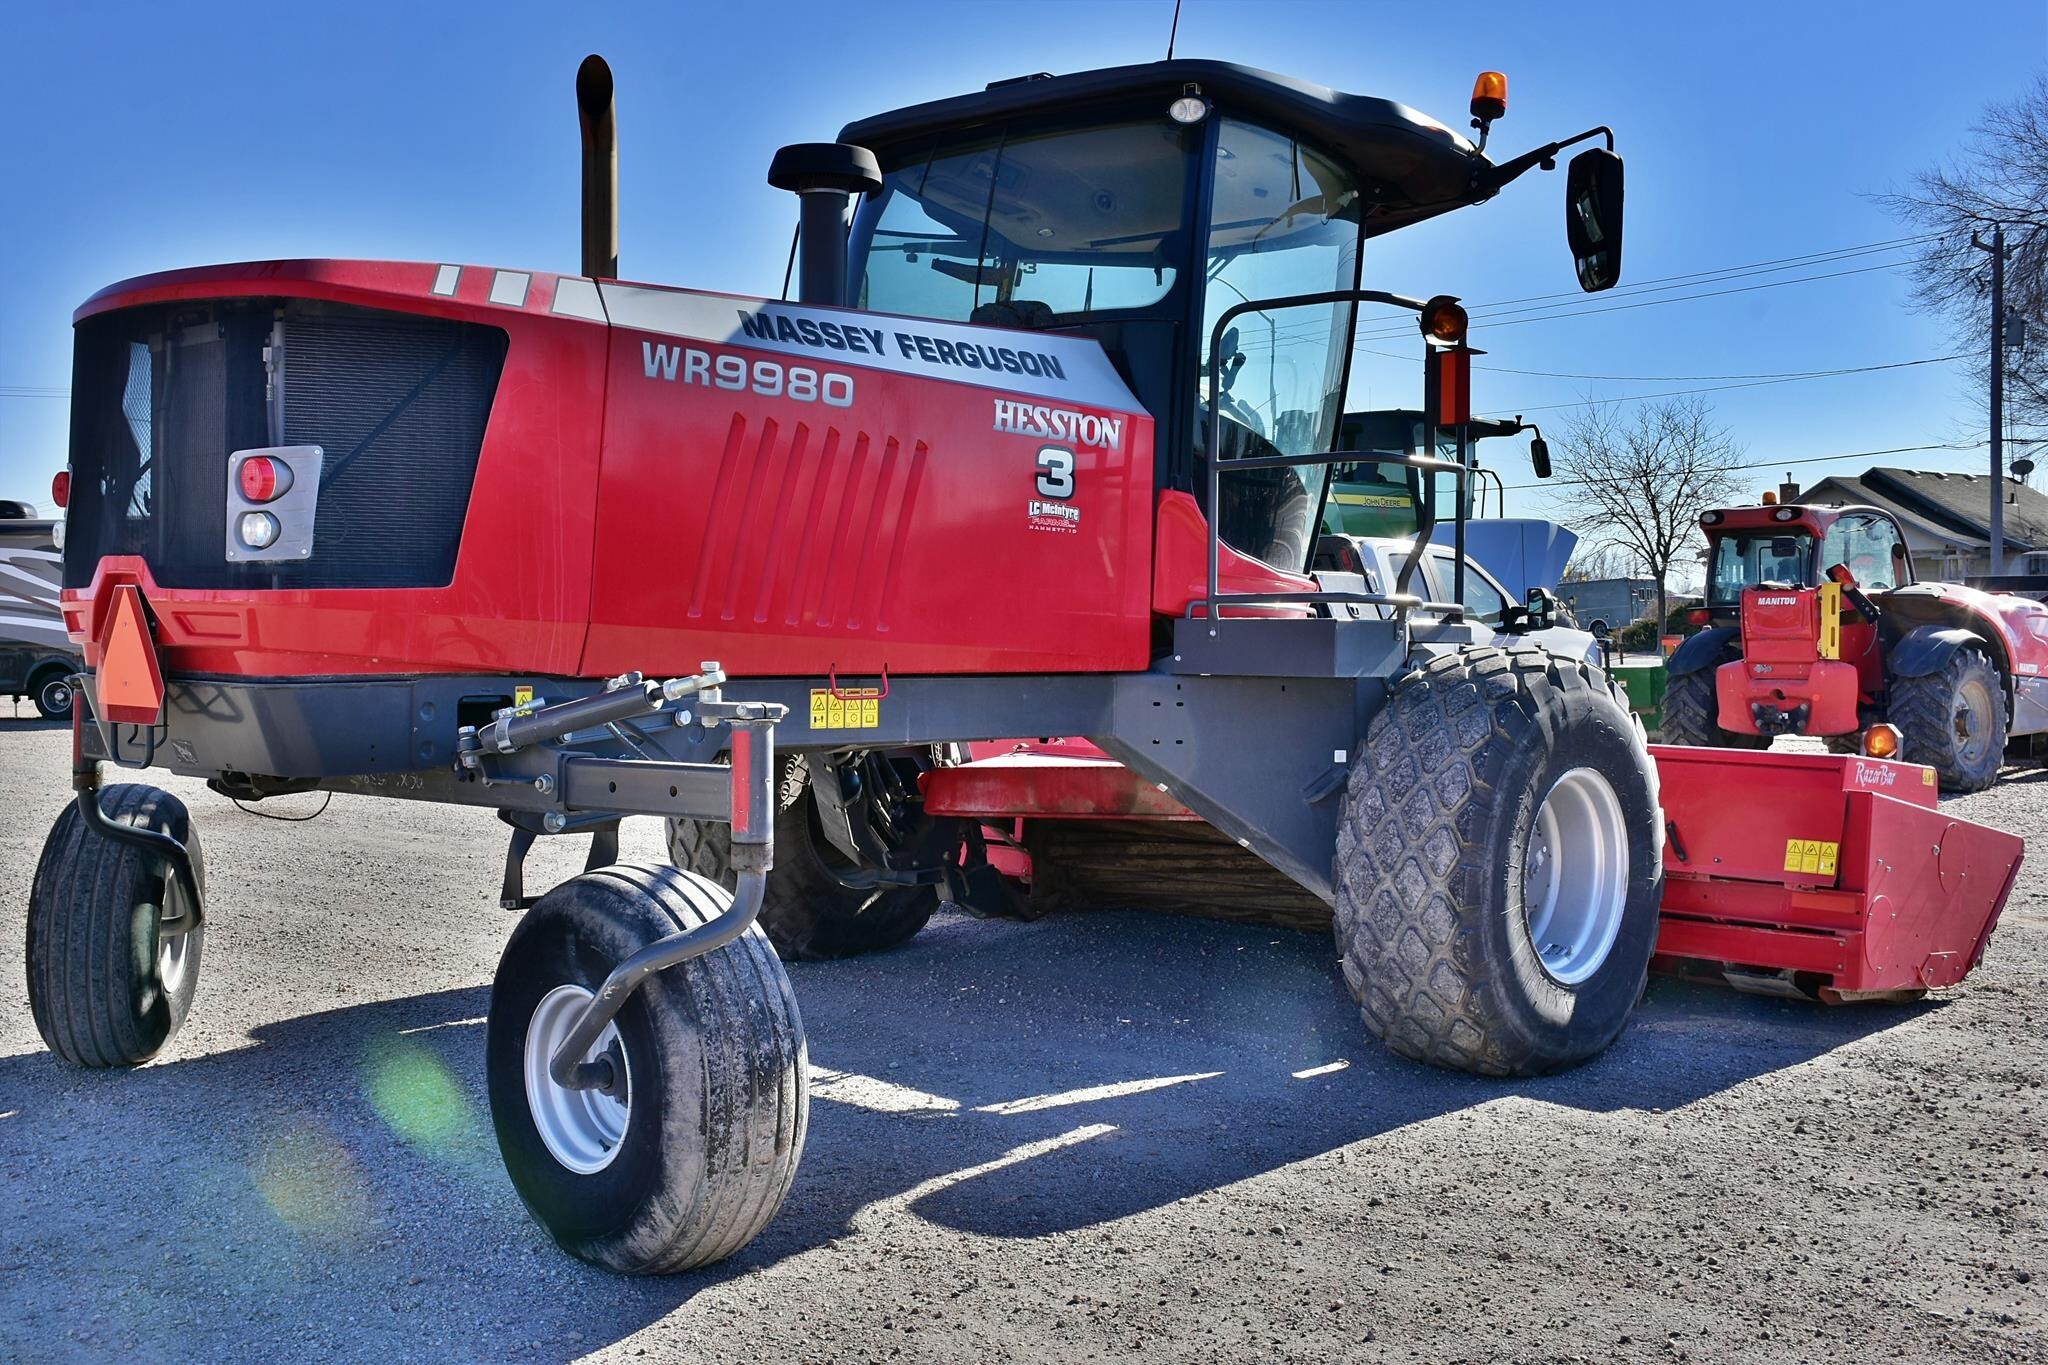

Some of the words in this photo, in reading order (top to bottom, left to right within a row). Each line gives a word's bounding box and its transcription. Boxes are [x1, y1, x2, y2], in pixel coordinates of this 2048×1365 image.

[737, 310, 885, 356] MASSEY
[894, 332, 1067, 381] FERGUSON
[642, 340, 854, 408] WR9980
[993, 398, 1121, 449] HESSTON
[1036, 446, 1076, 499] 3
[1042, 502, 1079, 520] McIntyre
[1363, 497, 1380, 506] JOHN
[1381, 497, 1400, 507] DEERE
[1758, 597, 1797, 605] MANITOU
